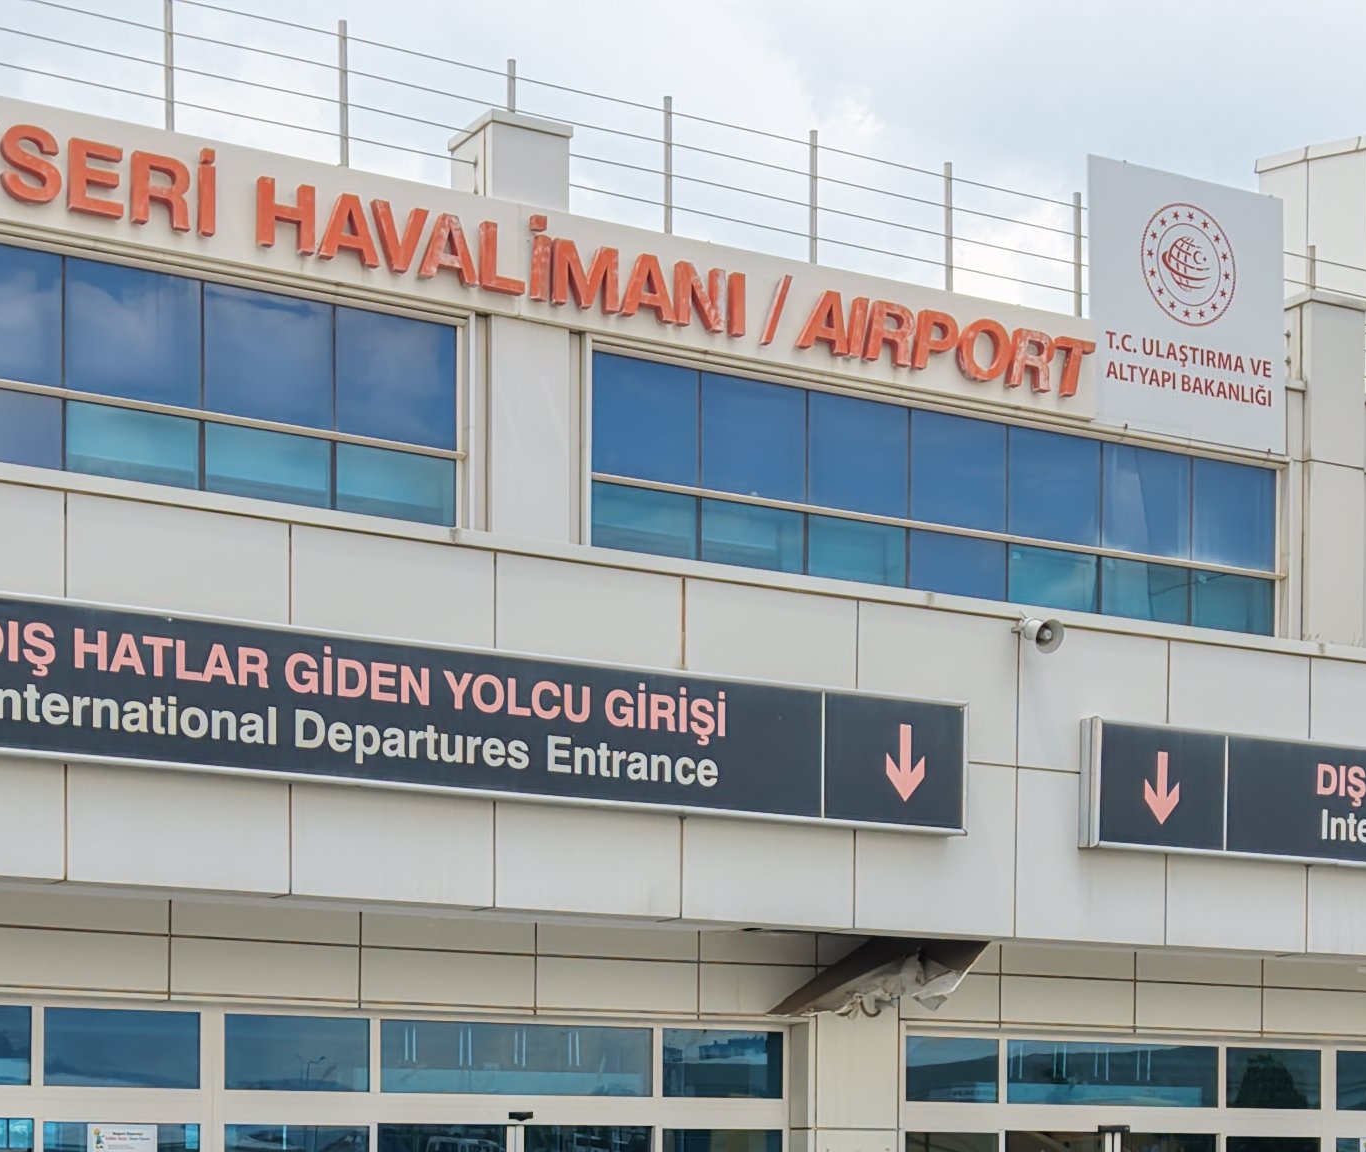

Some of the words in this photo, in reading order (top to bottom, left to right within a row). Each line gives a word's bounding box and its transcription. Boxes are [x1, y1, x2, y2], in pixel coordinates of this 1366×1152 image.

[256, 175, 745, 338] HAVALİMANI
[759, 274, 793, 346] /
[795, 290, 1096, 398] AIRPORT
[1105, 330, 1137, 354] T.C.
[1142, 337, 1245, 374] ULAŞTIRMA
[1250, 357, 1272, 379] VE
[1106, 361, 1176, 390] ALTYAPI
[1181, 374, 1272, 408] BAKANLIĞI
[73, 627, 269, 689] HATLAR
[284, 645, 430, 706] GİDEN
[443, 670, 591, 724] YOLCU
[604, 682, 727, 746] GİRİŞİ
[294, 708, 530, 770] Departures
[547, 735, 719, 788] Entrance
[1316, 763, 1366, 807] DIŞ
